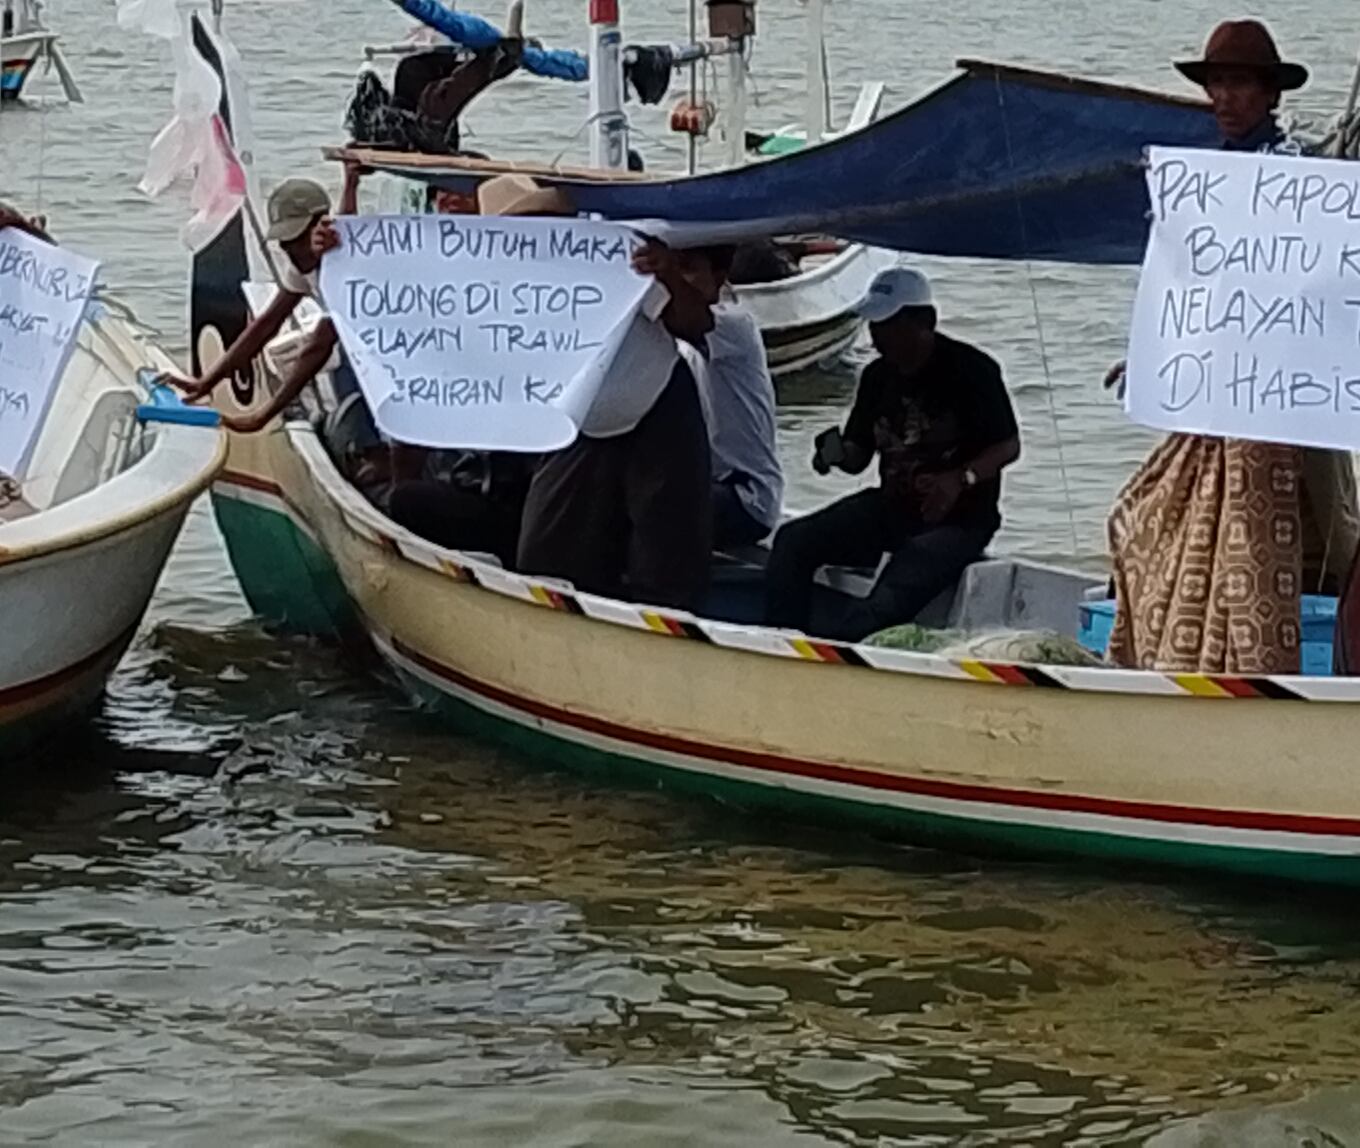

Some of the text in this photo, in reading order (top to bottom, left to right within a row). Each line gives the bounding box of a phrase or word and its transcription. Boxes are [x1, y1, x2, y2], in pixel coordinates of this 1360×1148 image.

[1153, 159, 1228, 223] PAK
[345, 215, 423, 258] KAMI
[439, 219, 538, 260] BUTUH
[1184, 224, 1321, 276] BANTU
[345, 278, 604, 325] TOLONG DI STOP
[1159, 286, 1325, 339] NELAYAN
[359, 323, 604, 359] ELAYAN TRAWL
[523, 375, 565, 404] KA
[1157, 350, 1213, 415] DI
